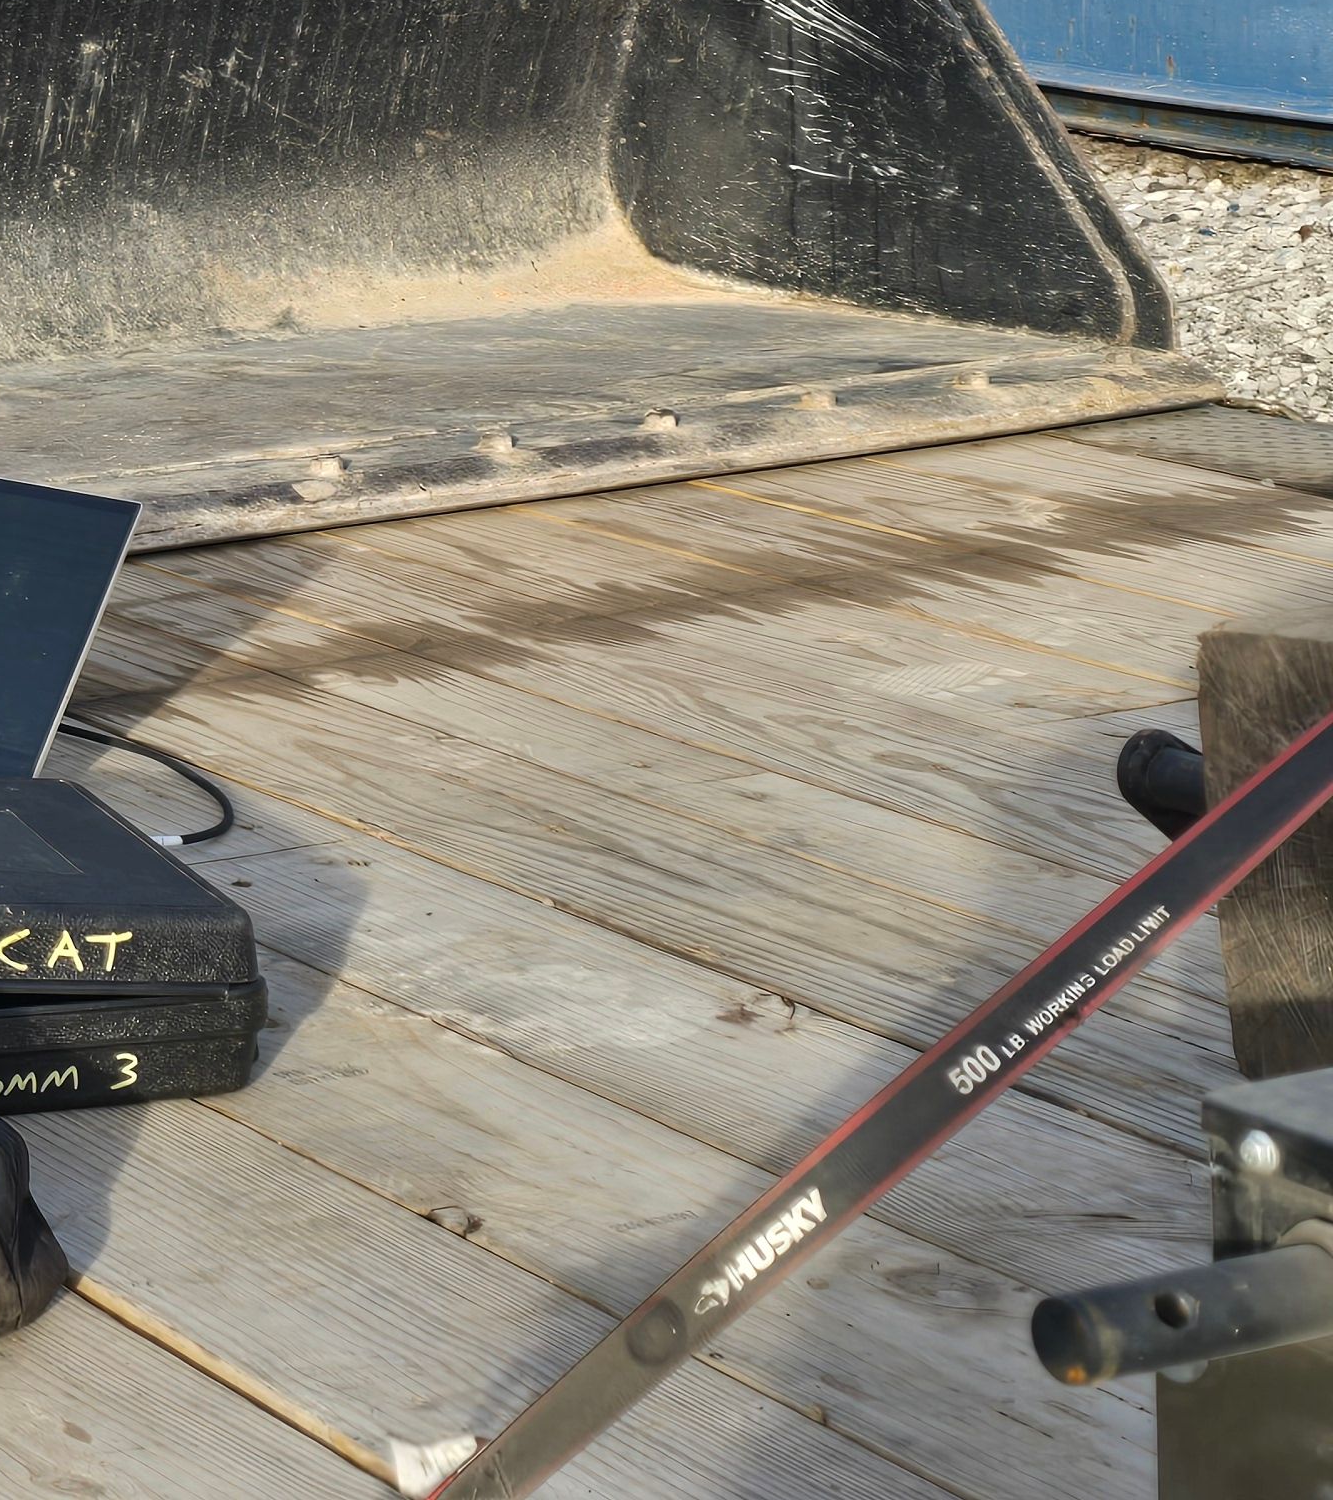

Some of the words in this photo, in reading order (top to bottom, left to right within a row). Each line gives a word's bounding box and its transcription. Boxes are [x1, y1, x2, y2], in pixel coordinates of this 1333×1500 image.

[947, 1045, 1002, 1095] 500
[1024, 974, 1097, 1036] WORKING
[1094, 938, 1136, 977] LOAD
[1131, 904, 1171, 943] LIMIT
[110, 1052, 138, 1090] 3
[725, 1187, 828, 1292] HUSKY
